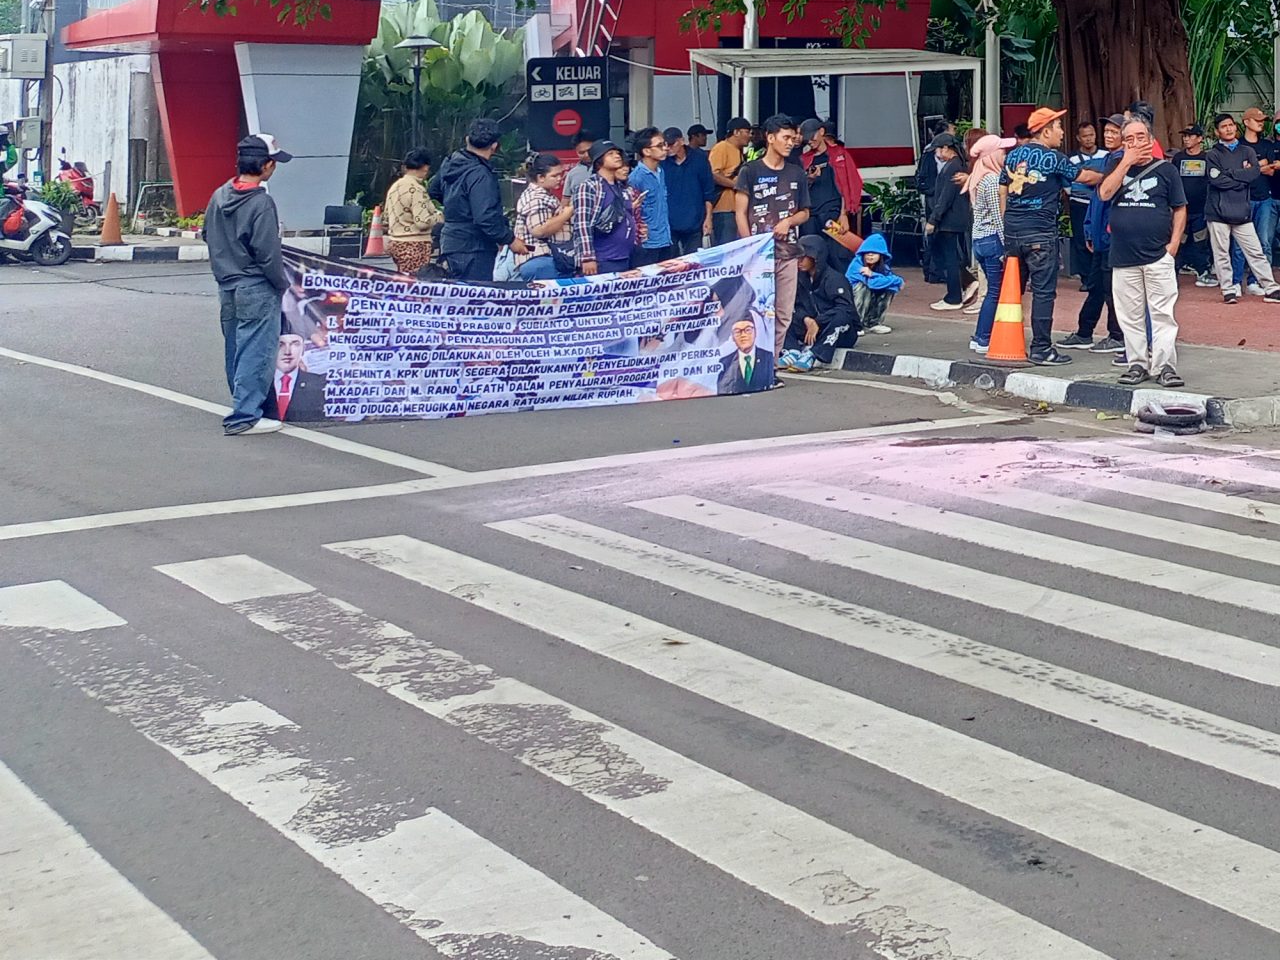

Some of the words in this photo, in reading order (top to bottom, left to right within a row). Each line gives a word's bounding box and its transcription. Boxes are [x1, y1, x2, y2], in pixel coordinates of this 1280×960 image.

[556, 66, 601, 80] KELUAR
[304, 275, 369, 291] BONGKAR
[375, 282, 405, 294] DAN
[411, 284, 446, 297] ADILI
[450, 287, 506, 299] DUGAAN
[584, 282, 611, 295] DAN
[614, 278, 661, 291] KONFLIK
[665, 264, 744, 284] KEPENTINGAN
[351, 299, 442, 315] PENYALURAN
[446, 305, 514, 317] BANTUAN
[517, 304, 554, 317] DANA
[559, 297, 630, 314] PENDIDIKAN
[635, 296, 653, 306] PIP
[659, 291, 685, 303] DAN
[689, 288, 708, 300] KIP
[329, 318, 336, 326] 1.
[346, 317, 396, 327] MEMINTA
[405, 318, 455, 329] PRESIDEN
[463, 322, 512, 330] PRABOWO
[578, 315, 611, 327] UNTUK
[619, 307, 699, 323] MEMERINTAHKAN
[705, 303, 719, 313] KPK
[330, 334, 387, 344] MENGUSUT
[395, 334, 440, 344] DUGAAN
[448, 335, 544, 344] PENYALAHGUNAAN
[550, 330, 620, 343] KEWENANGAN
[626, 326, 659, 336] DALAM
[664, 317, 720, 333] PENYALURAN
[329, 351, 346, 361] PIP
[350, 352, 373, 361] DAN
[376, 352, 394, 361] KIP
[398, 351, 427, 361] YANG
[432, 351, 491, 361] DILAKUKAN
[495, 350, 521, 359] OLEH
[525, 348, 550, 358] OLEH
[344, 369, 392, 379] MEMINTA
[397, 369, 419, 379] KPK
[424, 368, 460, 379] UNTUK
[465, 367, 507, 377] SEGERA
[511, 362, 588, 376] DILAKUKANNYA
[593, 355, 657, 371] PENYELIDIKAN
[659, 354, 677, 364] DAN
[681, 348, 721, 360] PERIKSA
[327, 386, 380, 397] M.KADAFI
[384, 386, 407, 396] DAN
[410, 386, 422, 396] M.
[427, 385, 457, 395] RANO
[463, 382, 505, 394] ALFATH
[510, 380, 545, 392] DALAM
[549, 375, 613, 390] PENYALURAN
[617, 371, 659, 385] PROGRAM
[664, 368, 679, 377] PIP
[683, 366, 703, 376] DAN
[707, 363, 722, 373] KIP
[325, 403, 356, 415] YANG
[360, 403, 399, 414] DIDUGA
[403, 400, 464, 413] MERUGIKAN
[467, 399, 510, 411] NEGARA
[513, 395, 559, 407] RATUSAN
[562, 391, 595, 402] MILIAR
[597, 388, 636, 400] RUPIAH.
